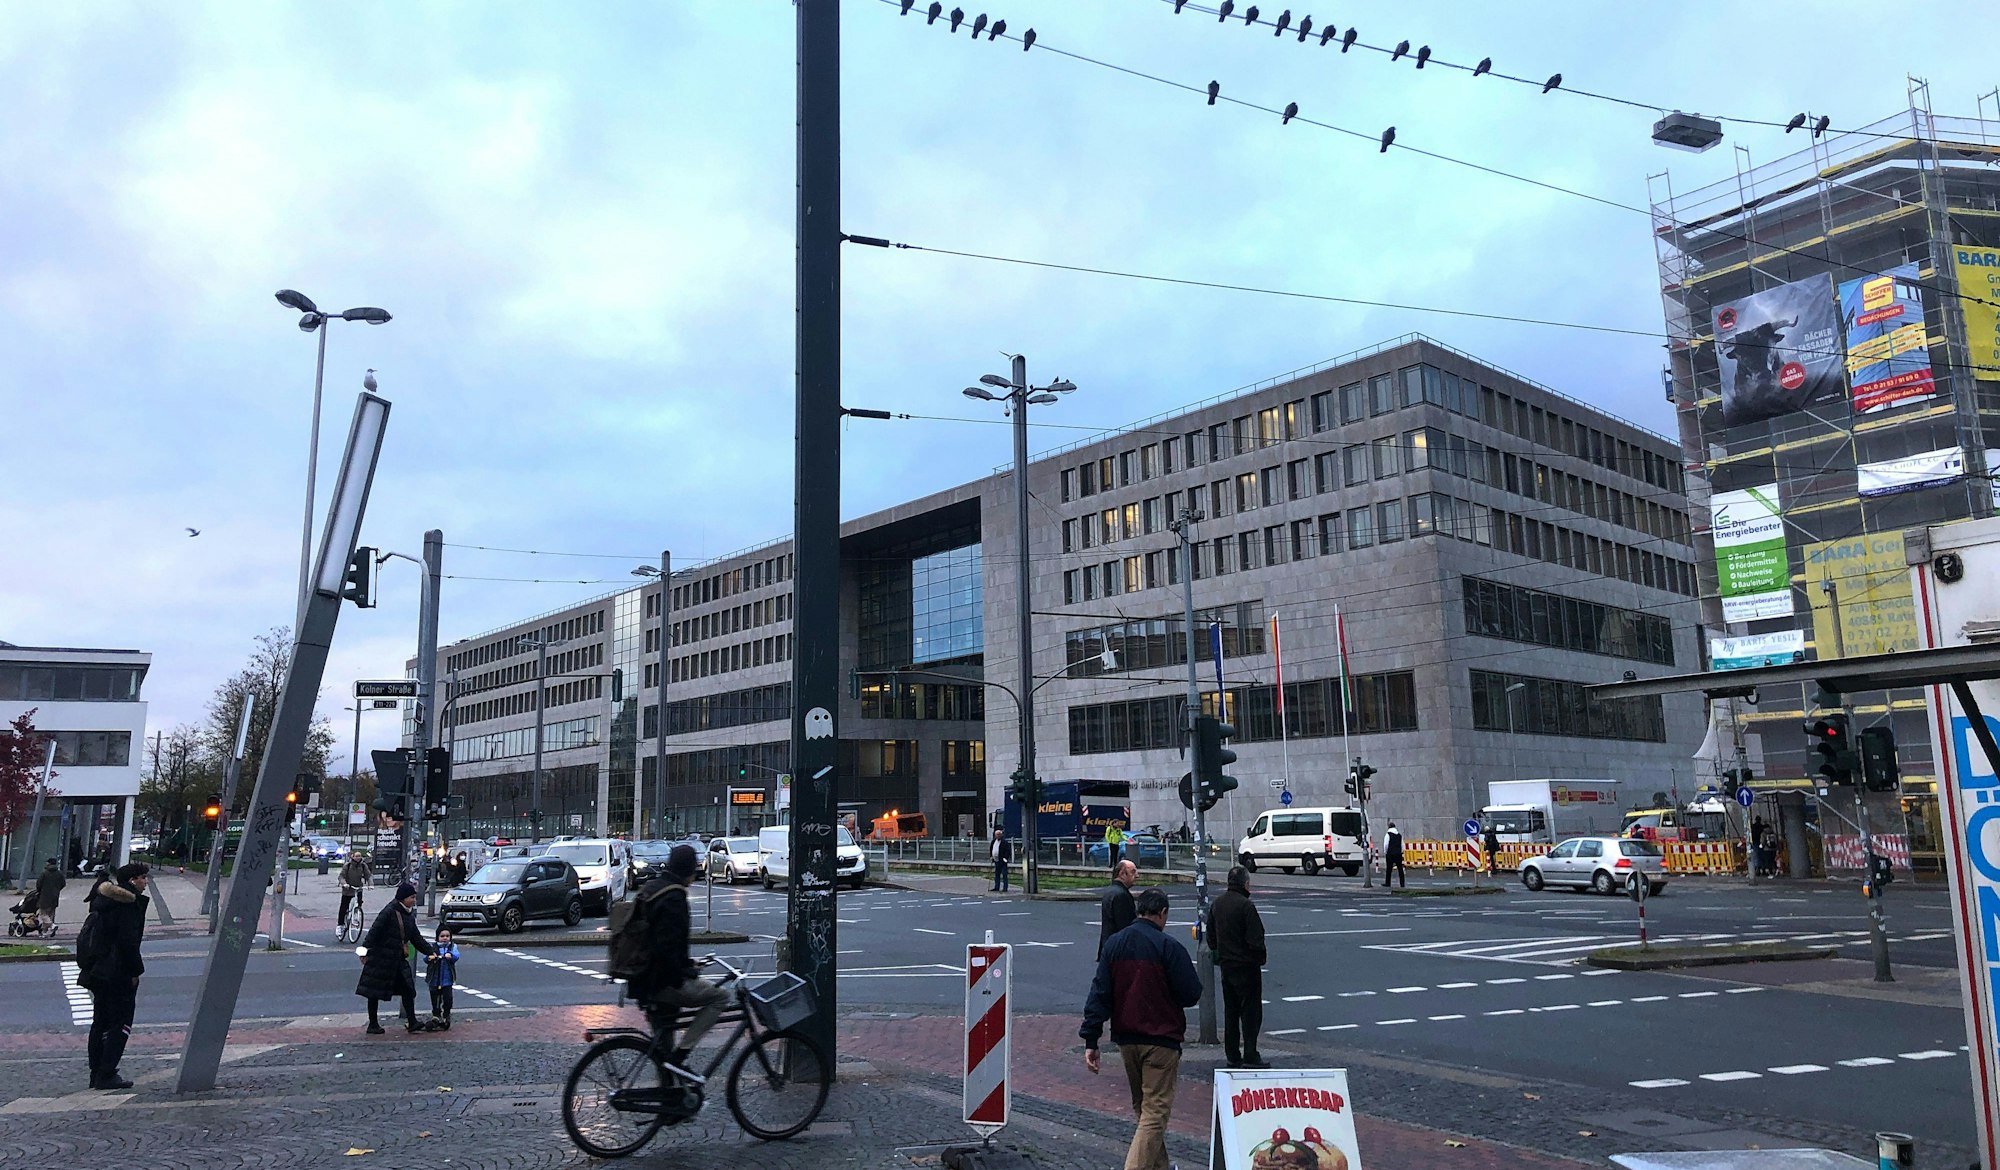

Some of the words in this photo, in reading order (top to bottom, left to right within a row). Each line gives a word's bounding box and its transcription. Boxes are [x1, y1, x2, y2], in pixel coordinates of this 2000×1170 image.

[1864, 286, 1892, 299] SCHIFFER
[1859, 307, 1901, 323] BEDACHUNGEN
[1804, 327, 1833, 342] DÄCHER
[1732, 519, 1747, 528] Die
[1715, 522, 1782, 539] Energieberater
[1735, 556, 1778, 570] Fördermittel
[1736, 568, 1773, 579] Nachweise
[1738, 578, 1775, 589] Bauleitung
[360, 684, 384, 695] Kölner
[387, 684, 413, 695] Straße
[1038, 800, 1073, 813] kleine
[1231, 1087, 1345, 1117] DÖNERKEBAP
